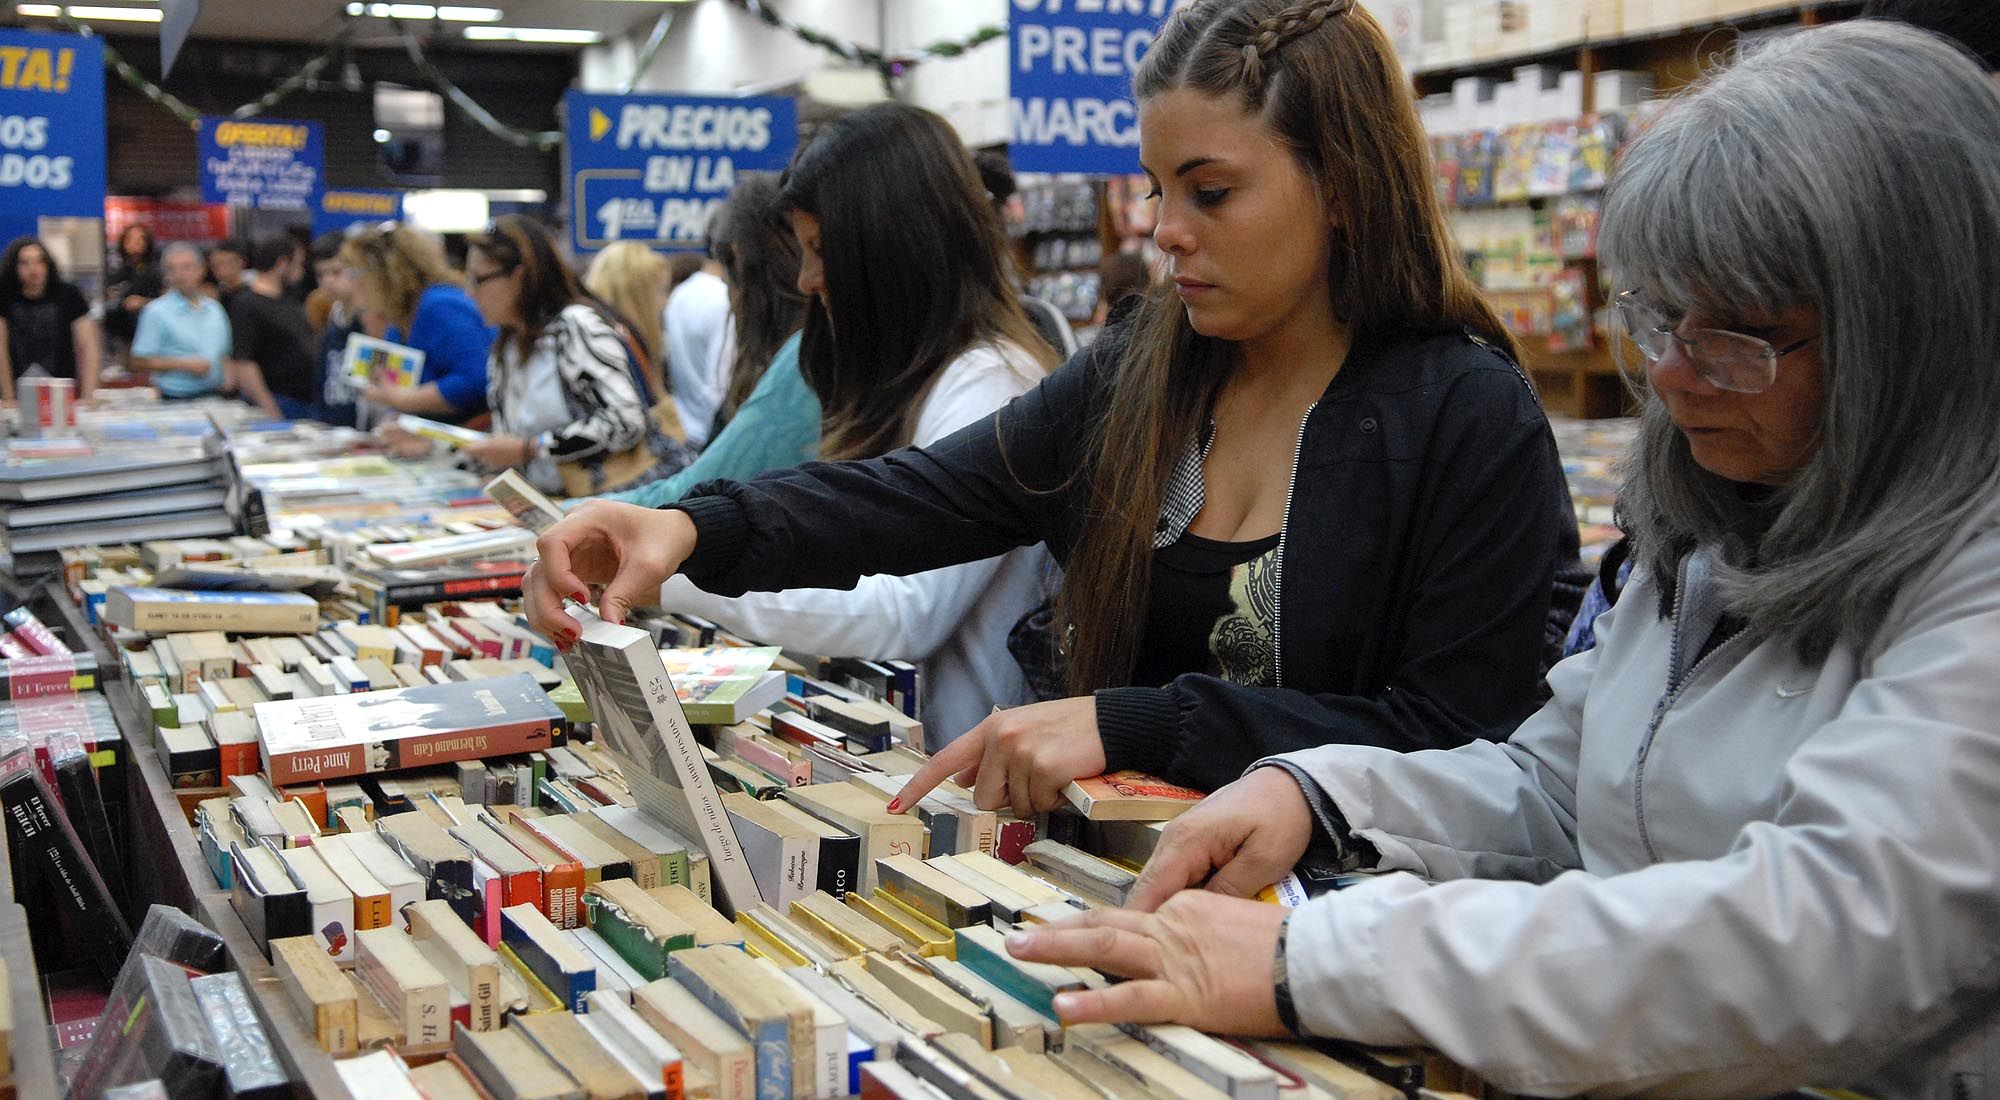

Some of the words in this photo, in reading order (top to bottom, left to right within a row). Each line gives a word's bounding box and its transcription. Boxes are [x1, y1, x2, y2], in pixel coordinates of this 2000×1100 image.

[616, 104, 773, 151] PRECIOS
[1009, 97, 1139, 147] MARC
[644, 155, 694, 193] EN
[695, 155, 736, 193] LA
[435, 737, 475, 752] hermano
[668, 718, 688, 755] POSADAS
[291, 753, 321, 774] Perry
[323, 751, 351, 769] Anne
[684, 755, 702, 789] CARMEN
[12, 804, 37, 838] REICH
[35, 804, 52, 828] Tercer
[700, 795, 716, 822] niños
[710, 819, 723, 834] de
[717, 834, 736, 862] Juego
[836, 869, 846, 901] LICO
[565, 887, 577, 928] SCHREIBER
[422, 1003, 437, 1019] S.
[479, 982, 491, 1032] Saint-Gil
[826, 1052, 839, 1082] JUDY
